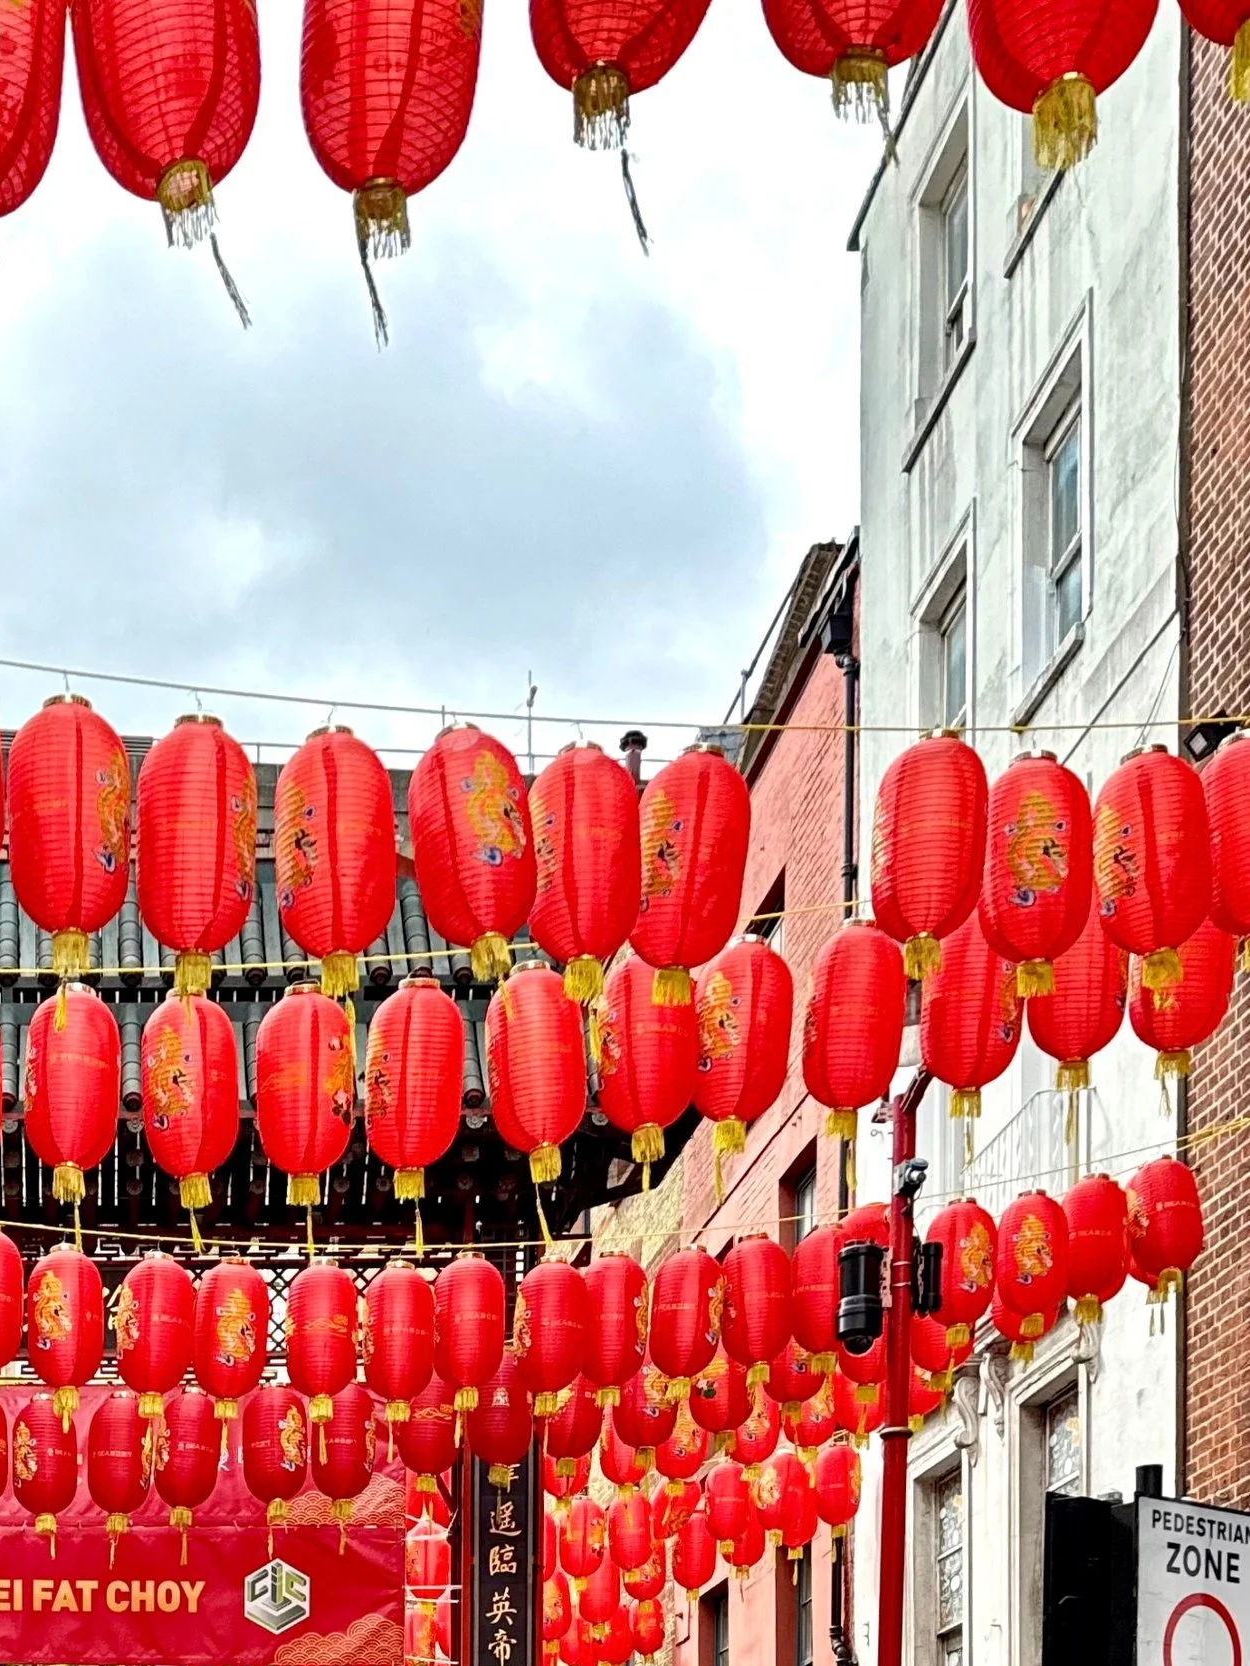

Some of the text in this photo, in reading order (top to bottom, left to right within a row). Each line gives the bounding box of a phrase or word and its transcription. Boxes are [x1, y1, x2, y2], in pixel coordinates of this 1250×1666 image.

[1166, 1541, 1241, 1584] ZONE
[32, 1579, 99, 1612] FAT
[106, 1580, 206, 1614] CHOY
